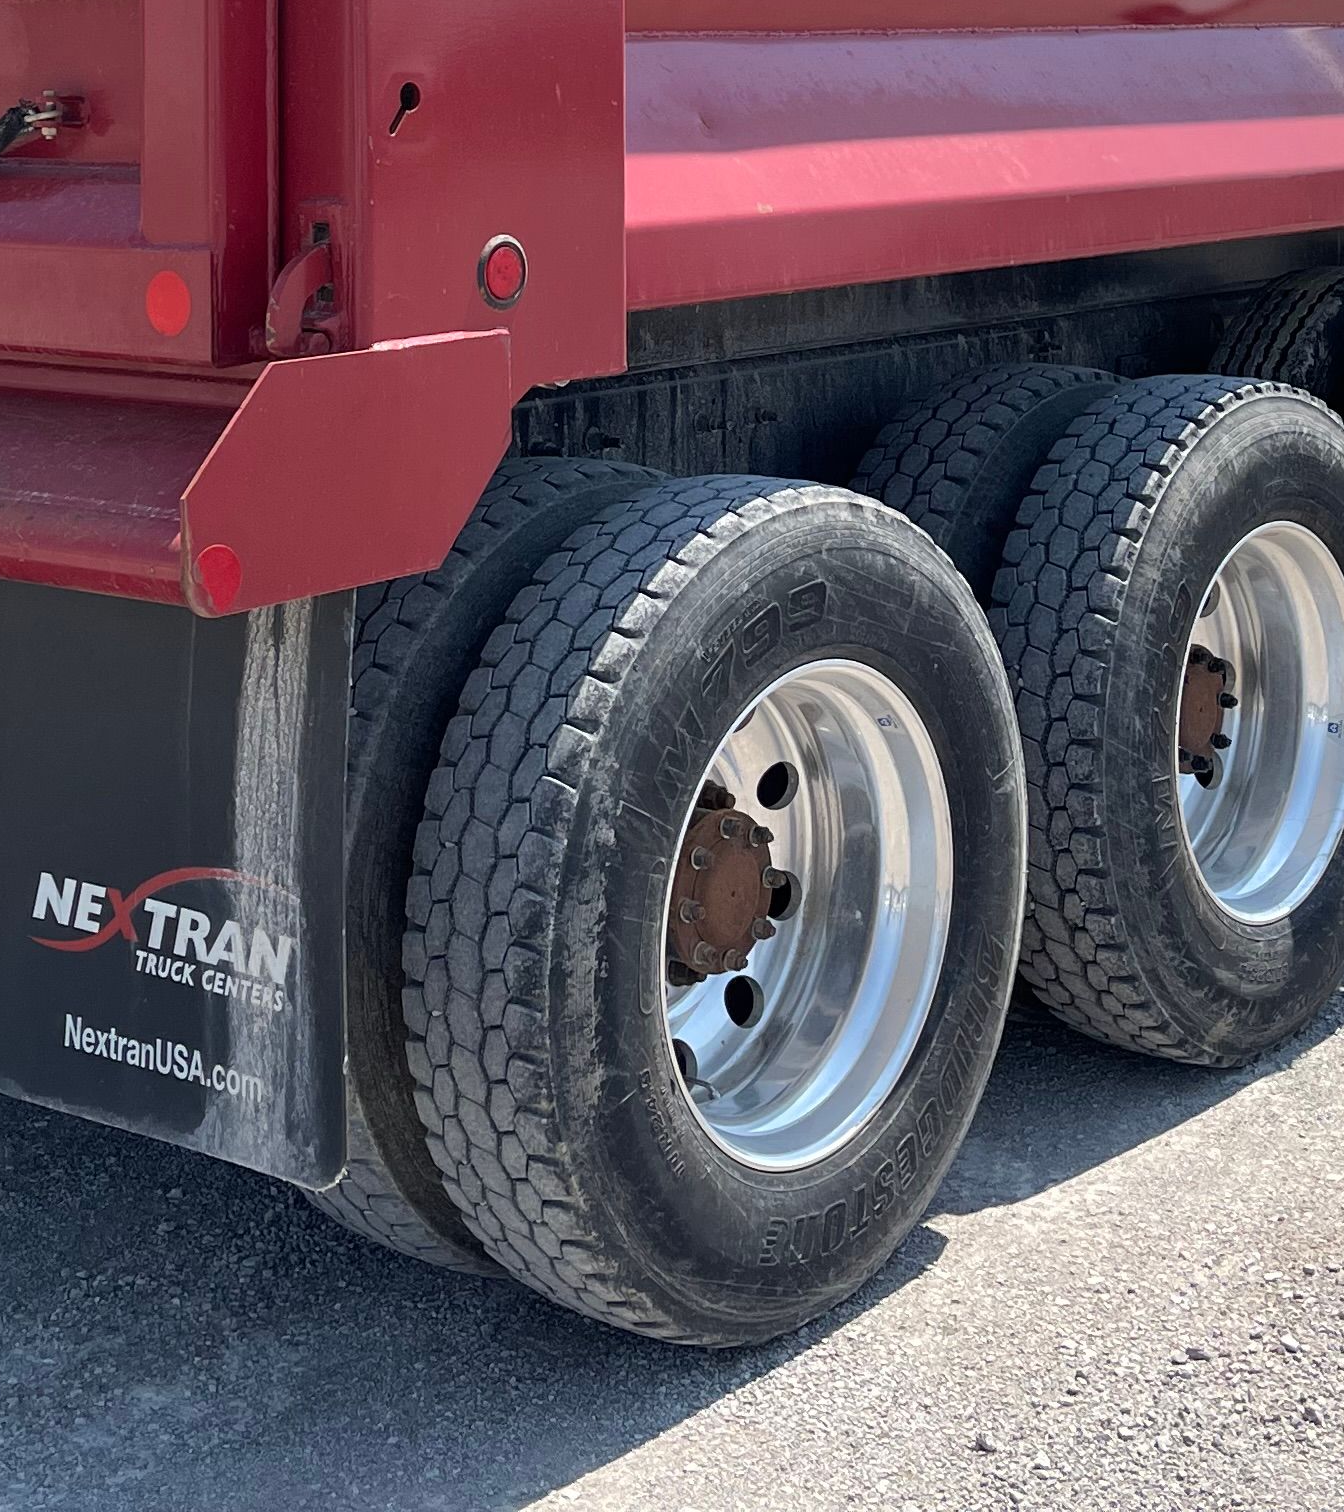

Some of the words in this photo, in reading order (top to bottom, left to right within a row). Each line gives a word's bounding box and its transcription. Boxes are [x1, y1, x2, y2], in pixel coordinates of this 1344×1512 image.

[31, 871, 293, 986] NEXTRAN
[134, 949, 196, 987] TRUCK
[201, 969, 285, 1013] CENTERS
[63, 1013, 263, 1103] NextranUSA.com
